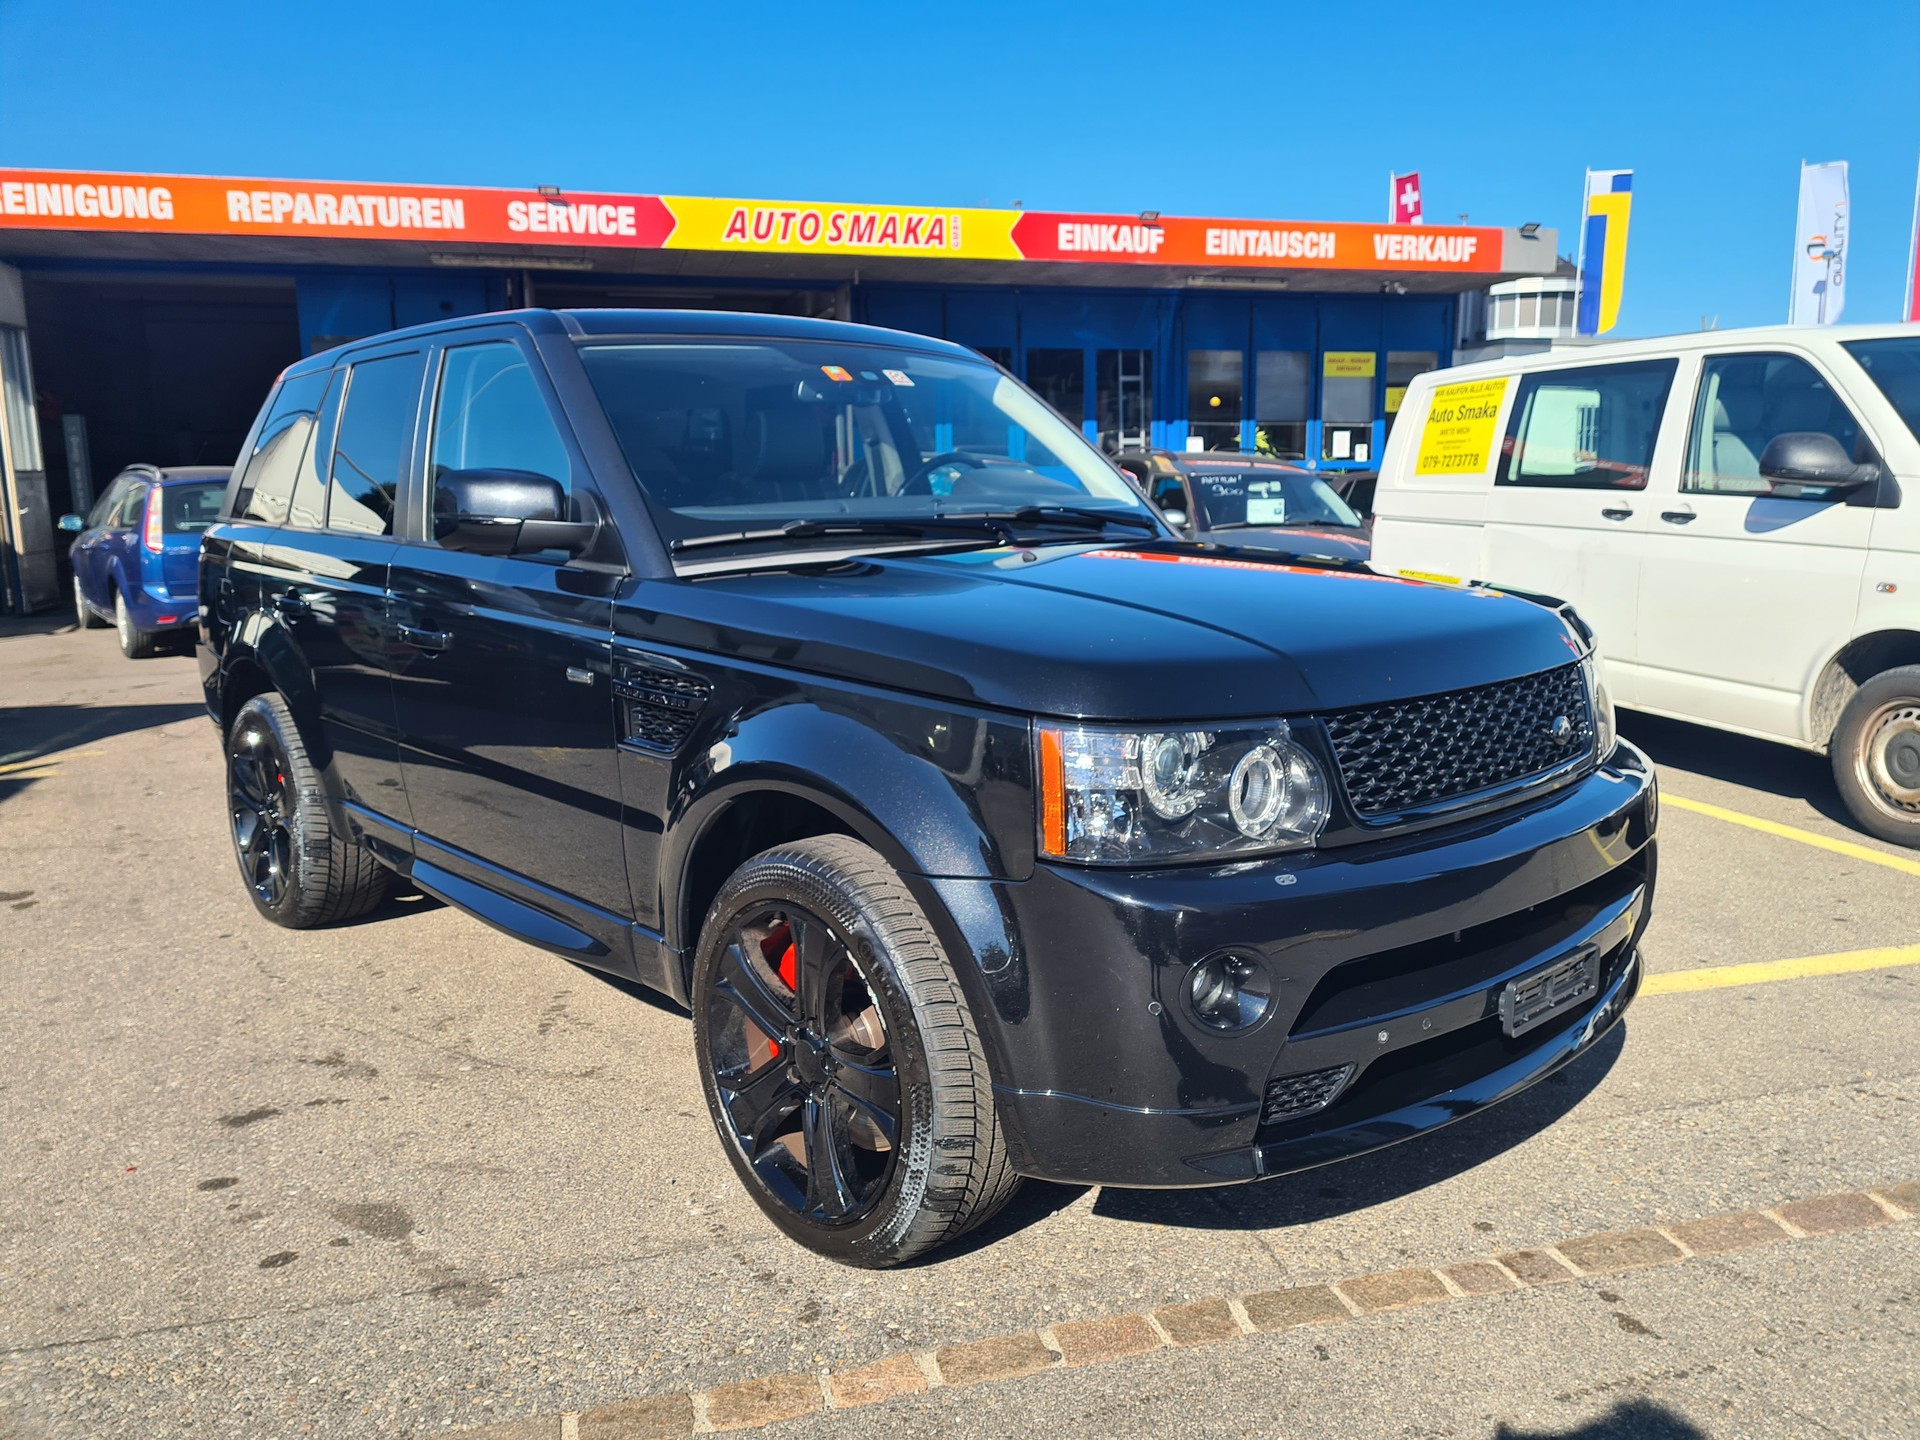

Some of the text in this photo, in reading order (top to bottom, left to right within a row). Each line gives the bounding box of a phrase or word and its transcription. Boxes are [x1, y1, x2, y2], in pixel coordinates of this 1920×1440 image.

[0, 181, 174, 220] EINIGUNG
[226, 188, 466, 230] REPARATUREN
[507, 200, 637, 236] SERVICE
[725, 209, 945, 246] AUTO SMAKA
[1057, 222, 1165, 254] EINKAUF
[1205, 228, 1336, 259] EINTAUSCH
[1373, 234, 1478, 263] VERKAUF
[1428, 401, 1497, 422] Auto Smaka
